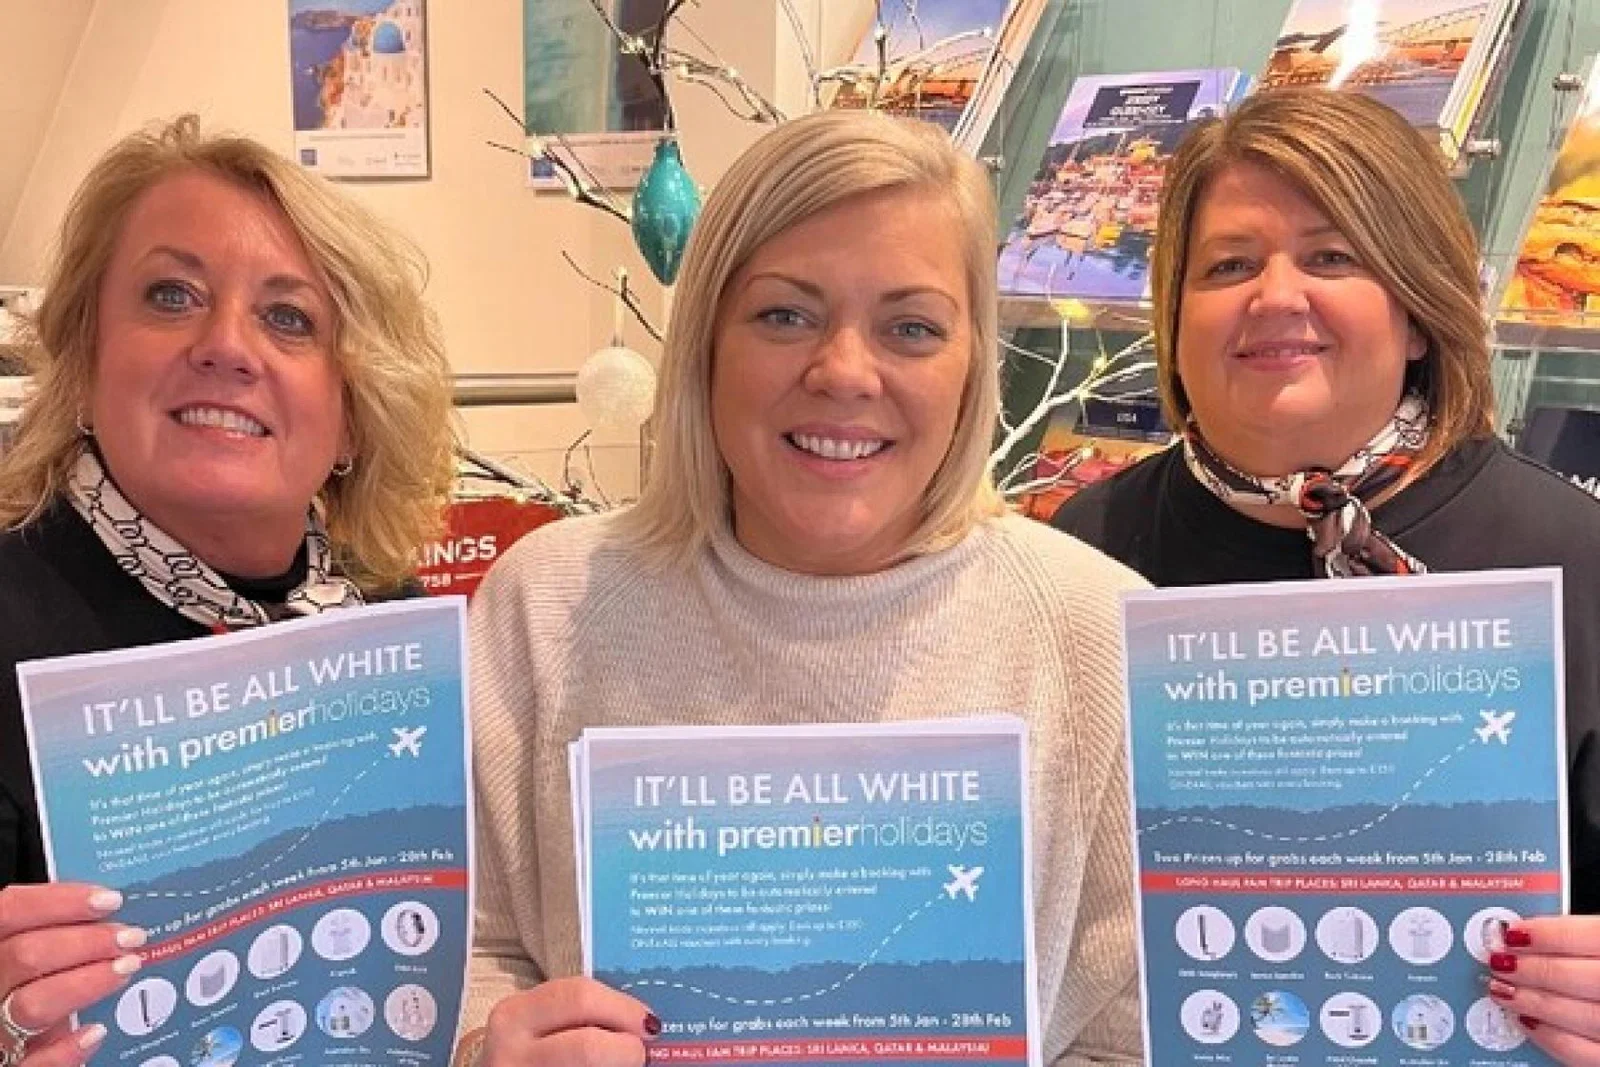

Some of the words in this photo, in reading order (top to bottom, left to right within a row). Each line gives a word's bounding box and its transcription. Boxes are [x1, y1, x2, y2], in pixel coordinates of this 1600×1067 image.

[417, 535, 497, 568] INGS
[1167, 633, 1247, 662] IT'LL
[1258, 629, 1300, 658] BE
[1312, 626, 1376, 656] ALL
[1386, 618, 1513, 653] WHITE
[83, 693, 175, 736] IT'LL
[187, 682, 230, 718] BE
[242, 666, 300, 709] ALL
[309, 642, 423, 687] WHITE
[1164, 670, 1237, 701] with
[82, 741, 169, 778] with
[634, 775, 717, 807] IT'LL
[727, 775, 773, 805] BE
[784, 772, 849, 803] ALL
[859, 770, 980, 802] WHITE
[629, 818, 707, 851] with
